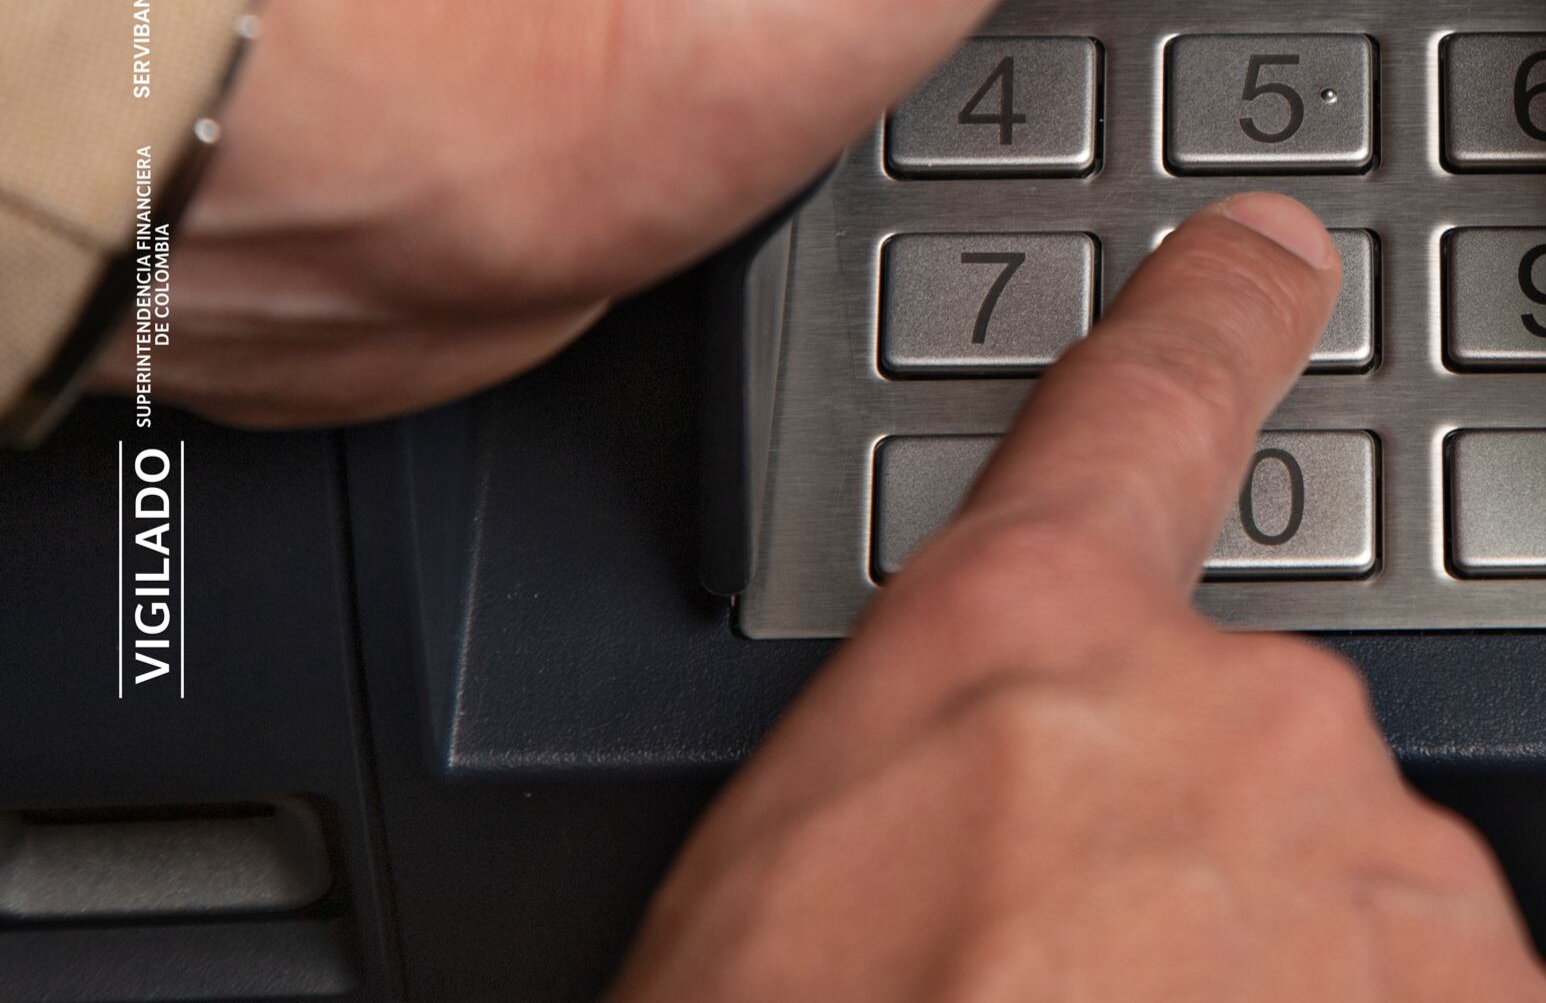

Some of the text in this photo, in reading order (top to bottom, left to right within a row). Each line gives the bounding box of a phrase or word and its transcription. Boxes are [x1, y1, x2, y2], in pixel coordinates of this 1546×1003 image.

[957, 56, 1027, 146] 4
[1238, 54, 1305, 143] 5
[960, 252, 1026, 344] 7
[1239, 448, 1305, 546] 0
